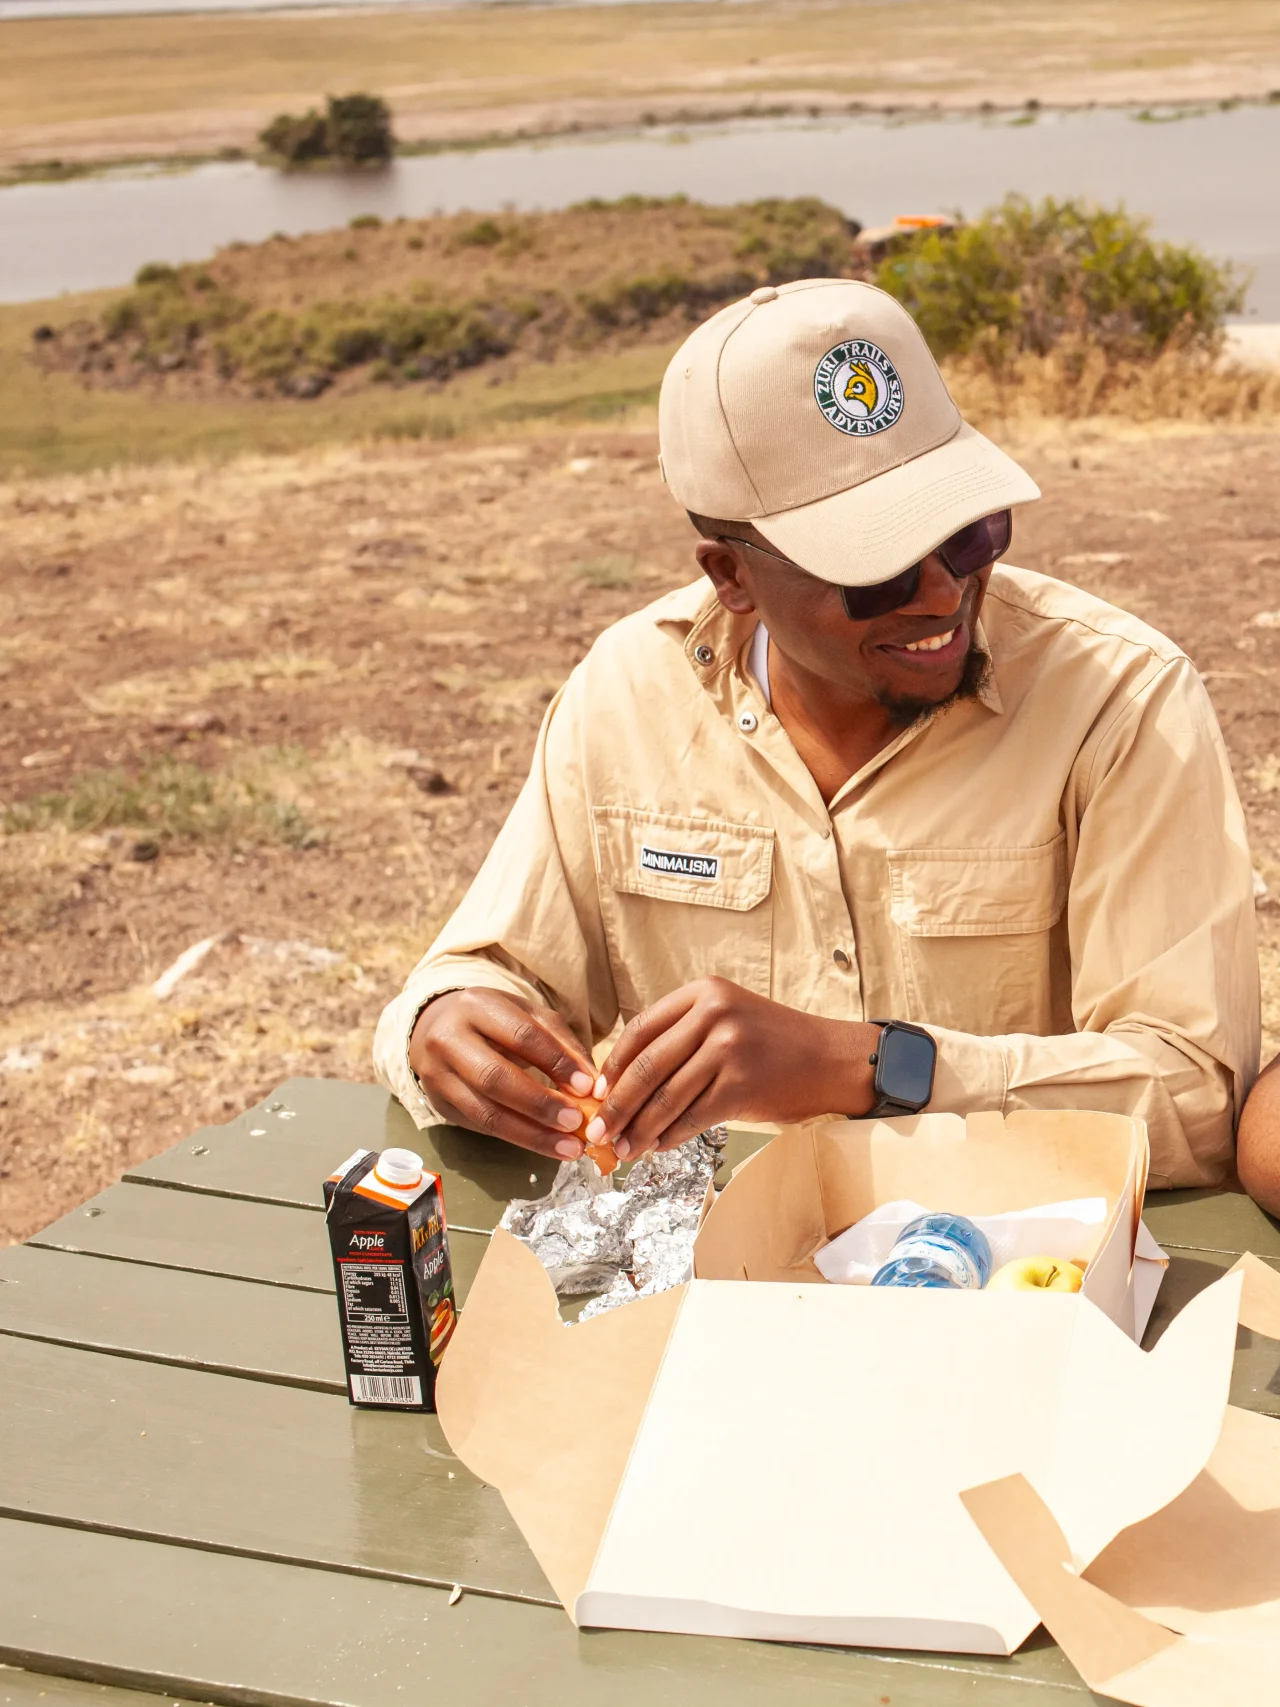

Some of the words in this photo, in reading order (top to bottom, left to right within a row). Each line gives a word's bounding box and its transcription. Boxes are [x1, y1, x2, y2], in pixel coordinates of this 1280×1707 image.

[818, 355, 839, 394] ZURI
[841, 343, 890, 372] TRAILS
[824, 380, 901, 433] ADVENTURES
[642, 850, 716, 875] MINIMALISM
[349, 1233, 384, 1250] Apple
[423, 1250, 444, 1280] Apple
